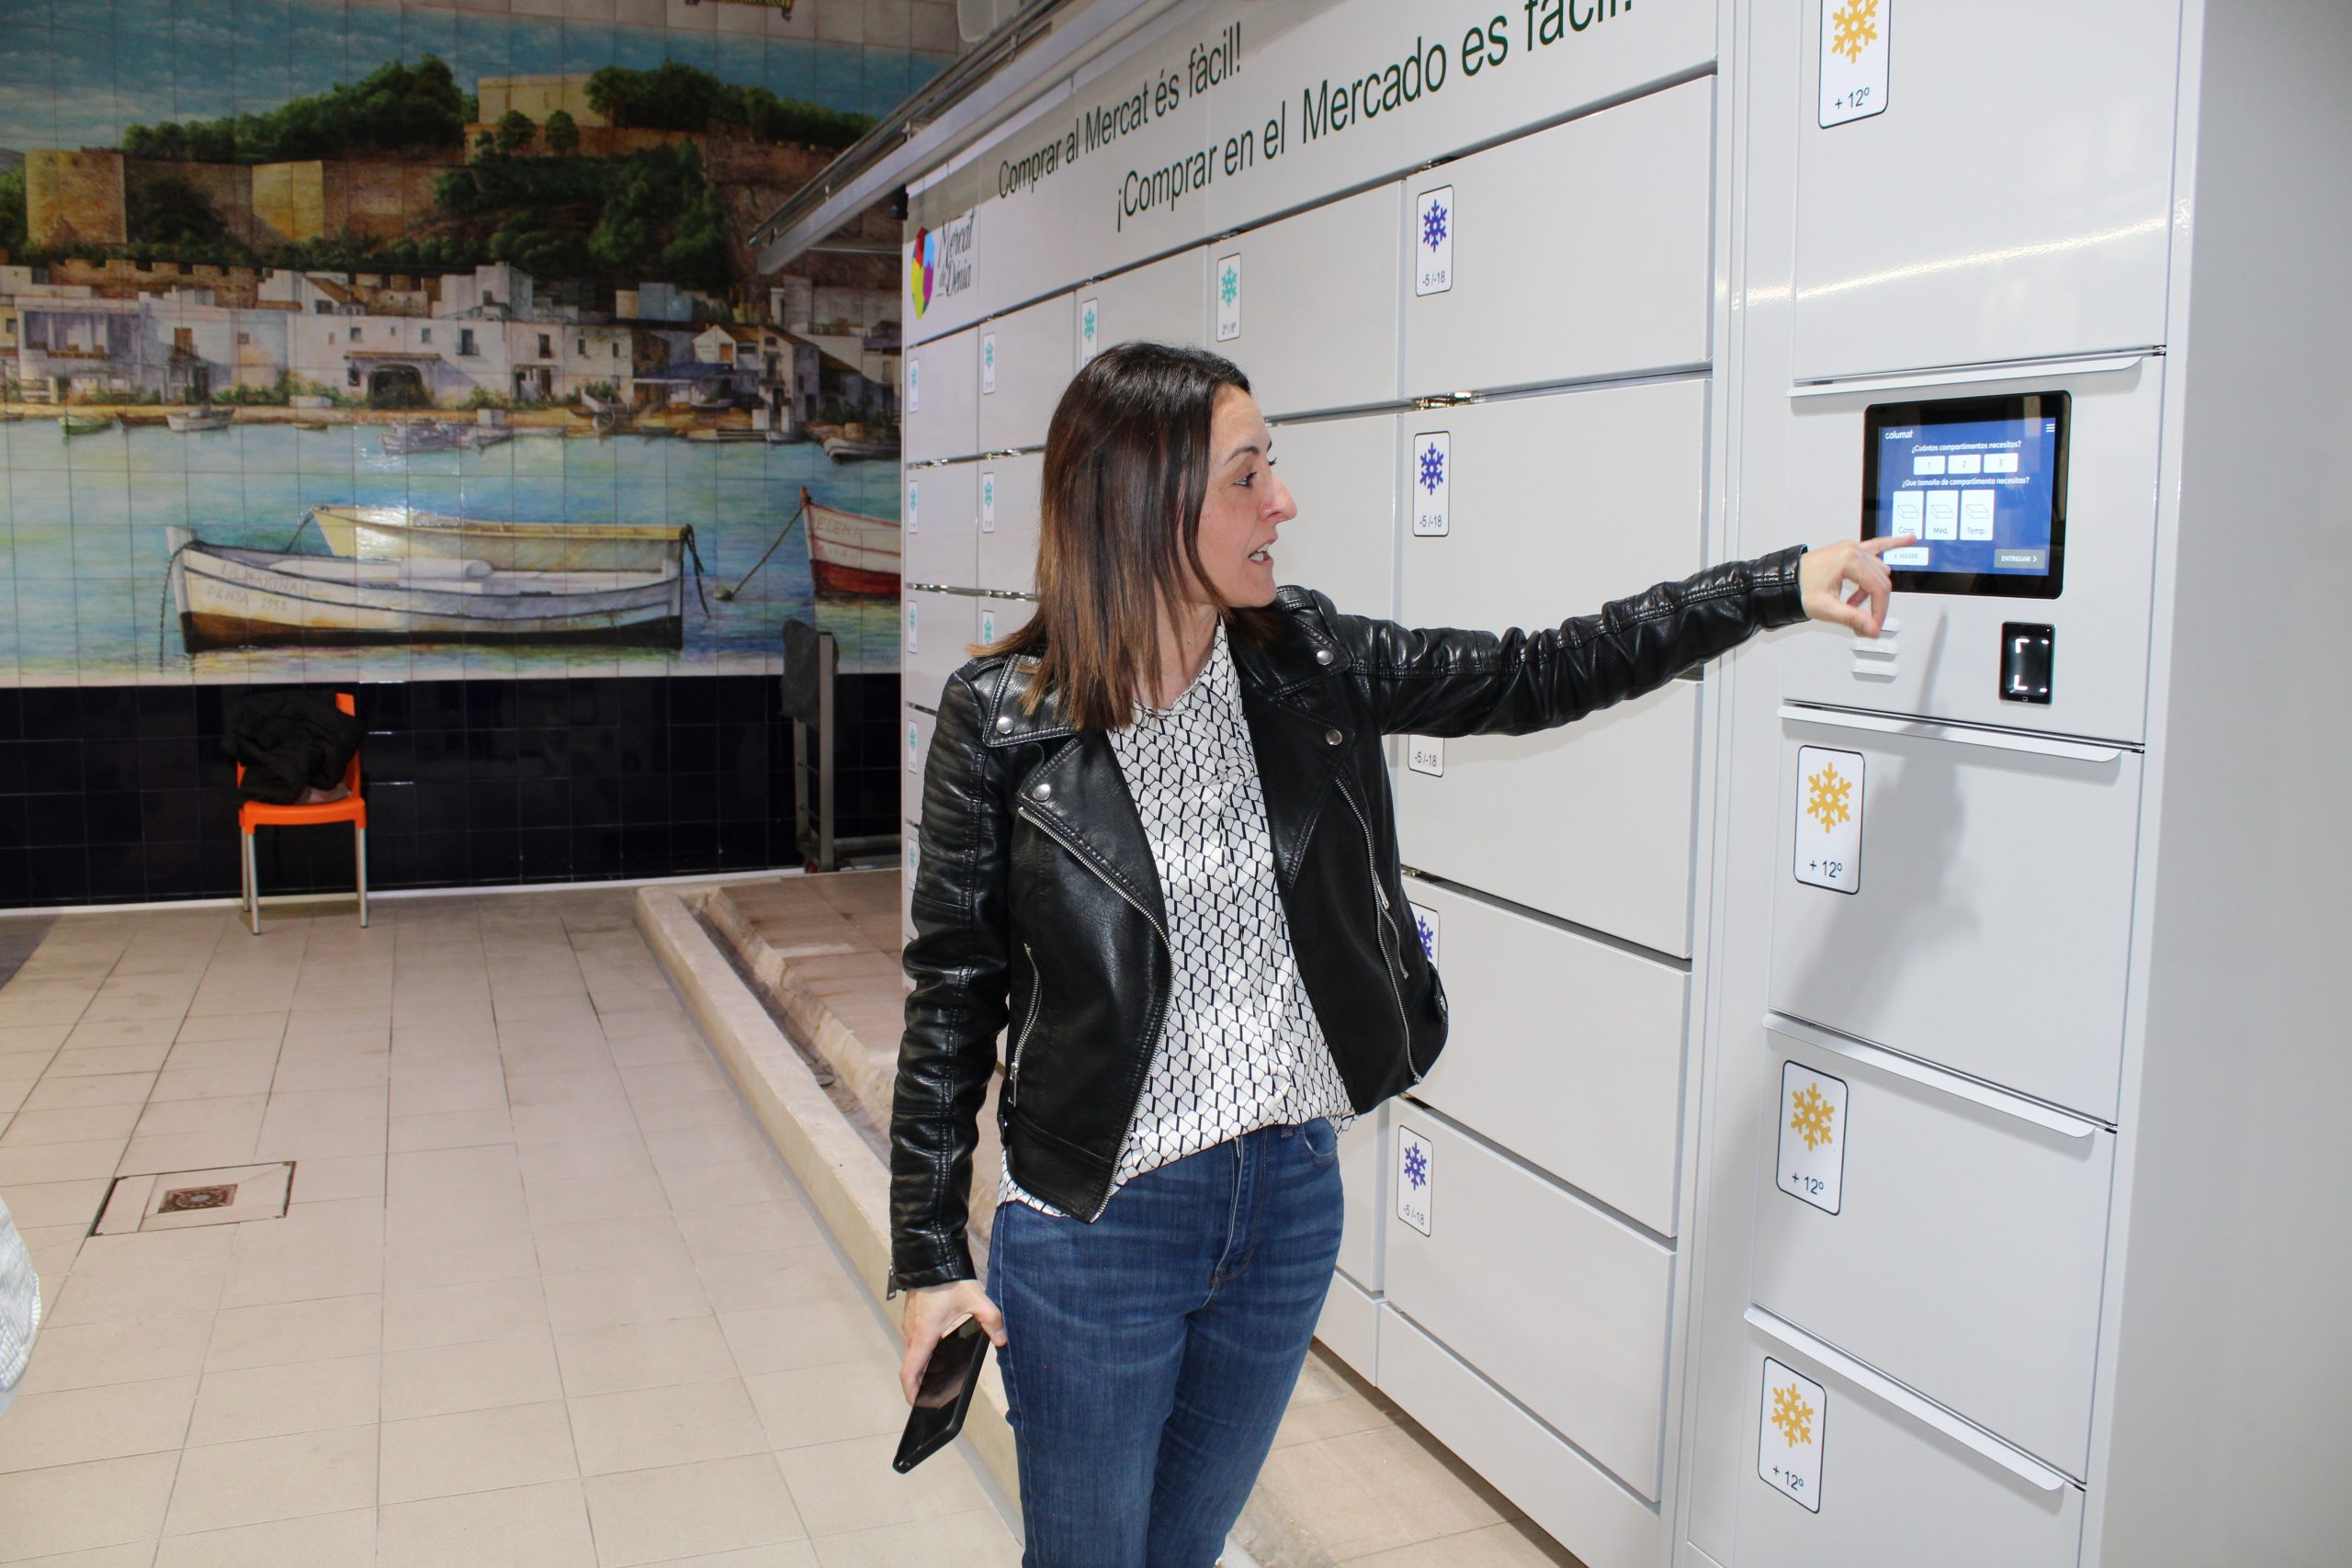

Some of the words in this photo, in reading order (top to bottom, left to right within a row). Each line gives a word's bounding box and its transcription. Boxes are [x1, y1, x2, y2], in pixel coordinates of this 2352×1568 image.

[999, 138, 1062, 199] Comprar
[1066, 118, 1079, 164] al
[1085, 81, 1148, 155] Mercat
[1155, 68, 1180, 118] és
[1188, 21, 1241, 98] fàcil!
[1117, 145, 1217, 233] ¡Comprar
[1224, 130, 1253, 176] en
[1263, 100, 1286, 160] el
[1302, 36, 1447, 144] Mercado
[1461, 15, 1509, 77] es
[937, 206, 977, 269] Mercat
[1940, 478, 1949, 486] de
[2000, 555, 2031, 563] ENTREGAR
